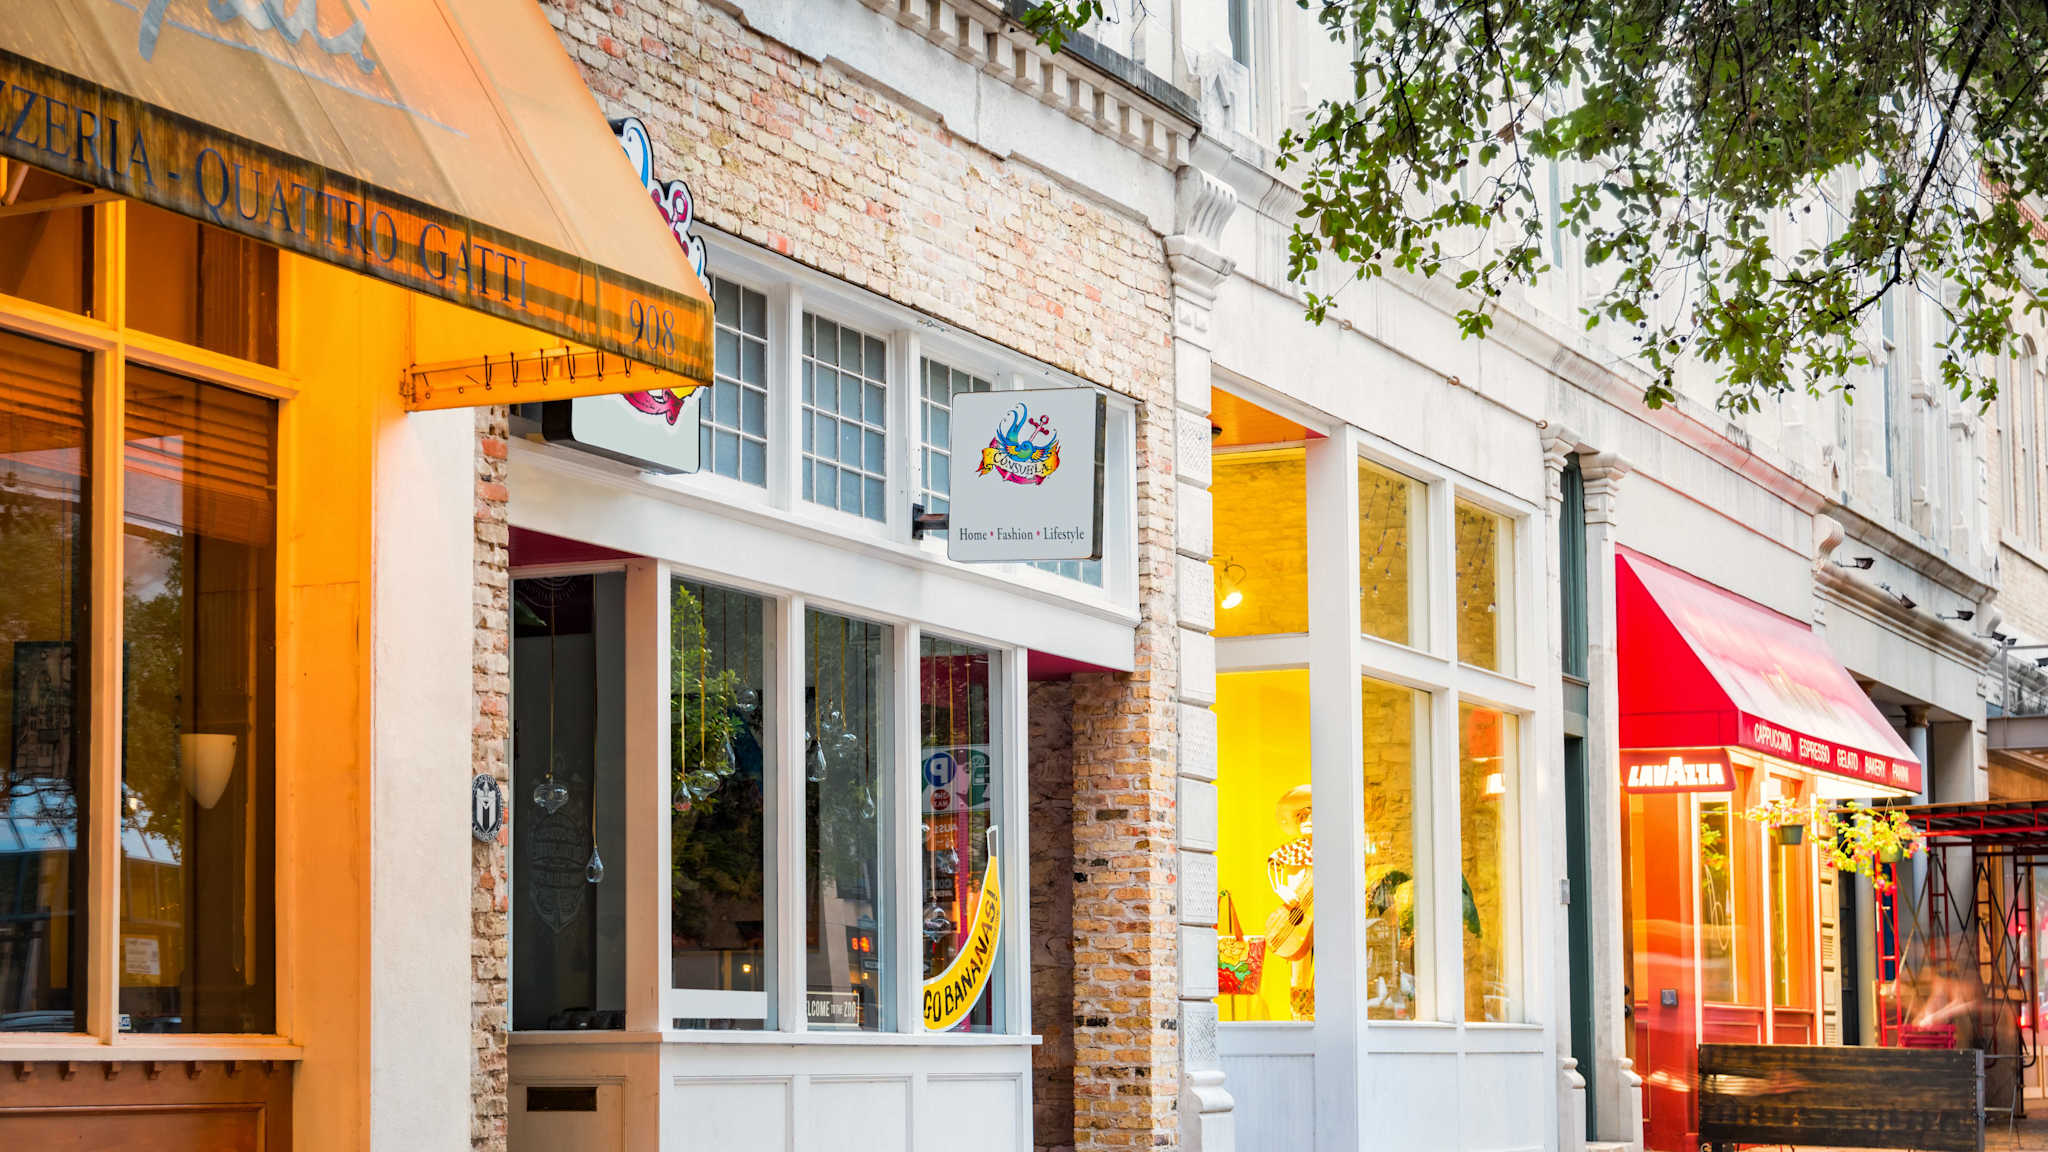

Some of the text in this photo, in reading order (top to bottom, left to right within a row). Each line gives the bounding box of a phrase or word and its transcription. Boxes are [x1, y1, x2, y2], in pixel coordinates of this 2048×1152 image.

[0, 80, 154, 186] ZERIA
[196, 147, 397, 263] QUATTRO
[419, 223, 528, 309] GATTI
[629, 299, 675, 355] 908
[993, 452, 1052, 475] CONSUELA
[959, 526, 1085, 543] Home Fashion Lifestyle
[1754, 722, 1792, 753] CAPPUCCINO
[1799, 737, 1830, 764] ESPRESSO
[1836, 748, 1859, 771] GELATO
[1864, 755, 1886, 777] BAKERY
[1627, 756, 1725, 787] LAVAZZA
[923, 989, 942, 1022] GO
[944, 888, 998, 1016] BANANAS!
[843, 1000, 856, 1017] ZOO
